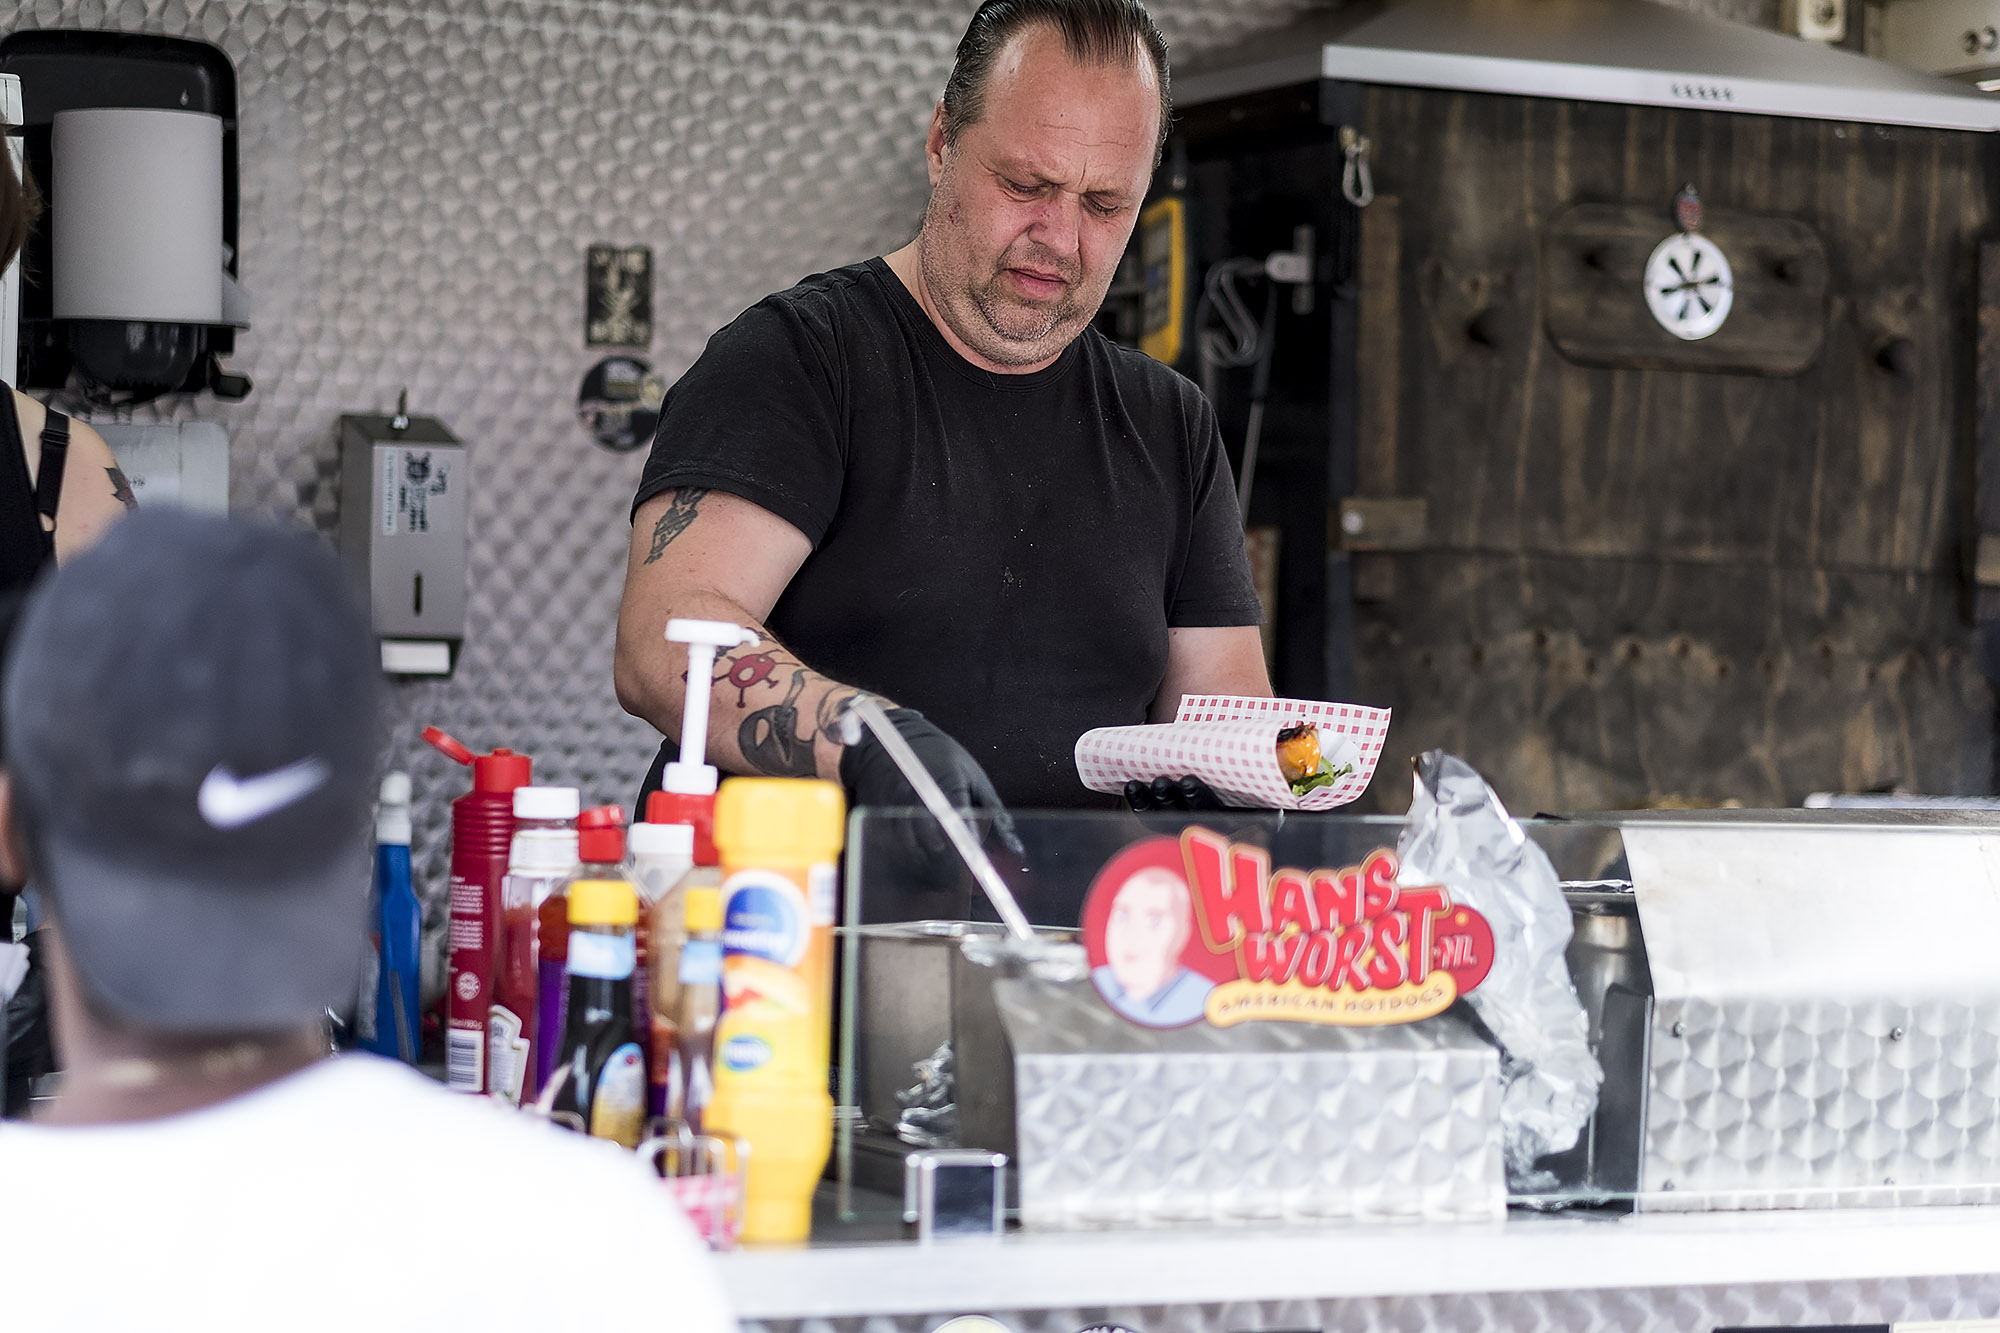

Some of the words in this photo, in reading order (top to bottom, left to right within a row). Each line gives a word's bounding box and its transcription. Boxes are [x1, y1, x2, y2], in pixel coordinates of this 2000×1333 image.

[1241, 887, 1449, 992] WORST
[1219, 993, 1336, 1013] AMERICAN
[1343, 984, 1444, 1013] HOTDOGS
